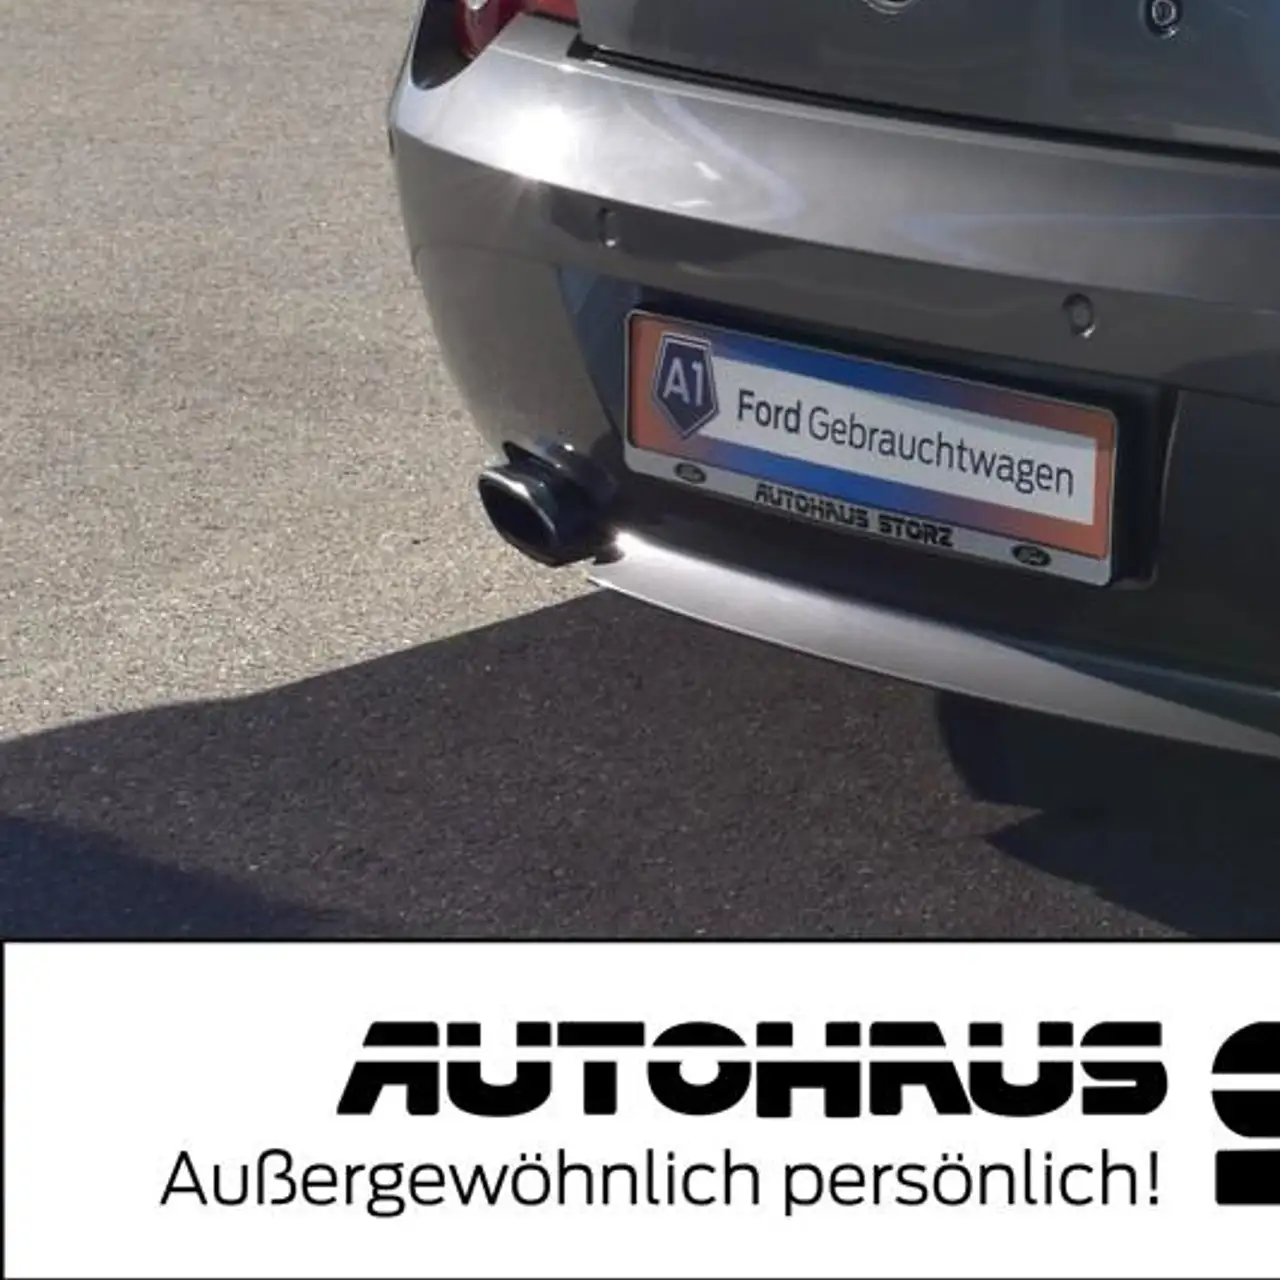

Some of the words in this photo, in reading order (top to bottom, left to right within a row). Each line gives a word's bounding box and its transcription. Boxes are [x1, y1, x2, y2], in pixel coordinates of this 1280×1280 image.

[662, 356, 702, 407] A1
[737, 389, 801, 435] Ford
[807, 405, 1074, 497] Gebrauchtwagen
[754, 483, 870, 529] AUTOHAUS
[877, 514, 955, 548] STORZ
